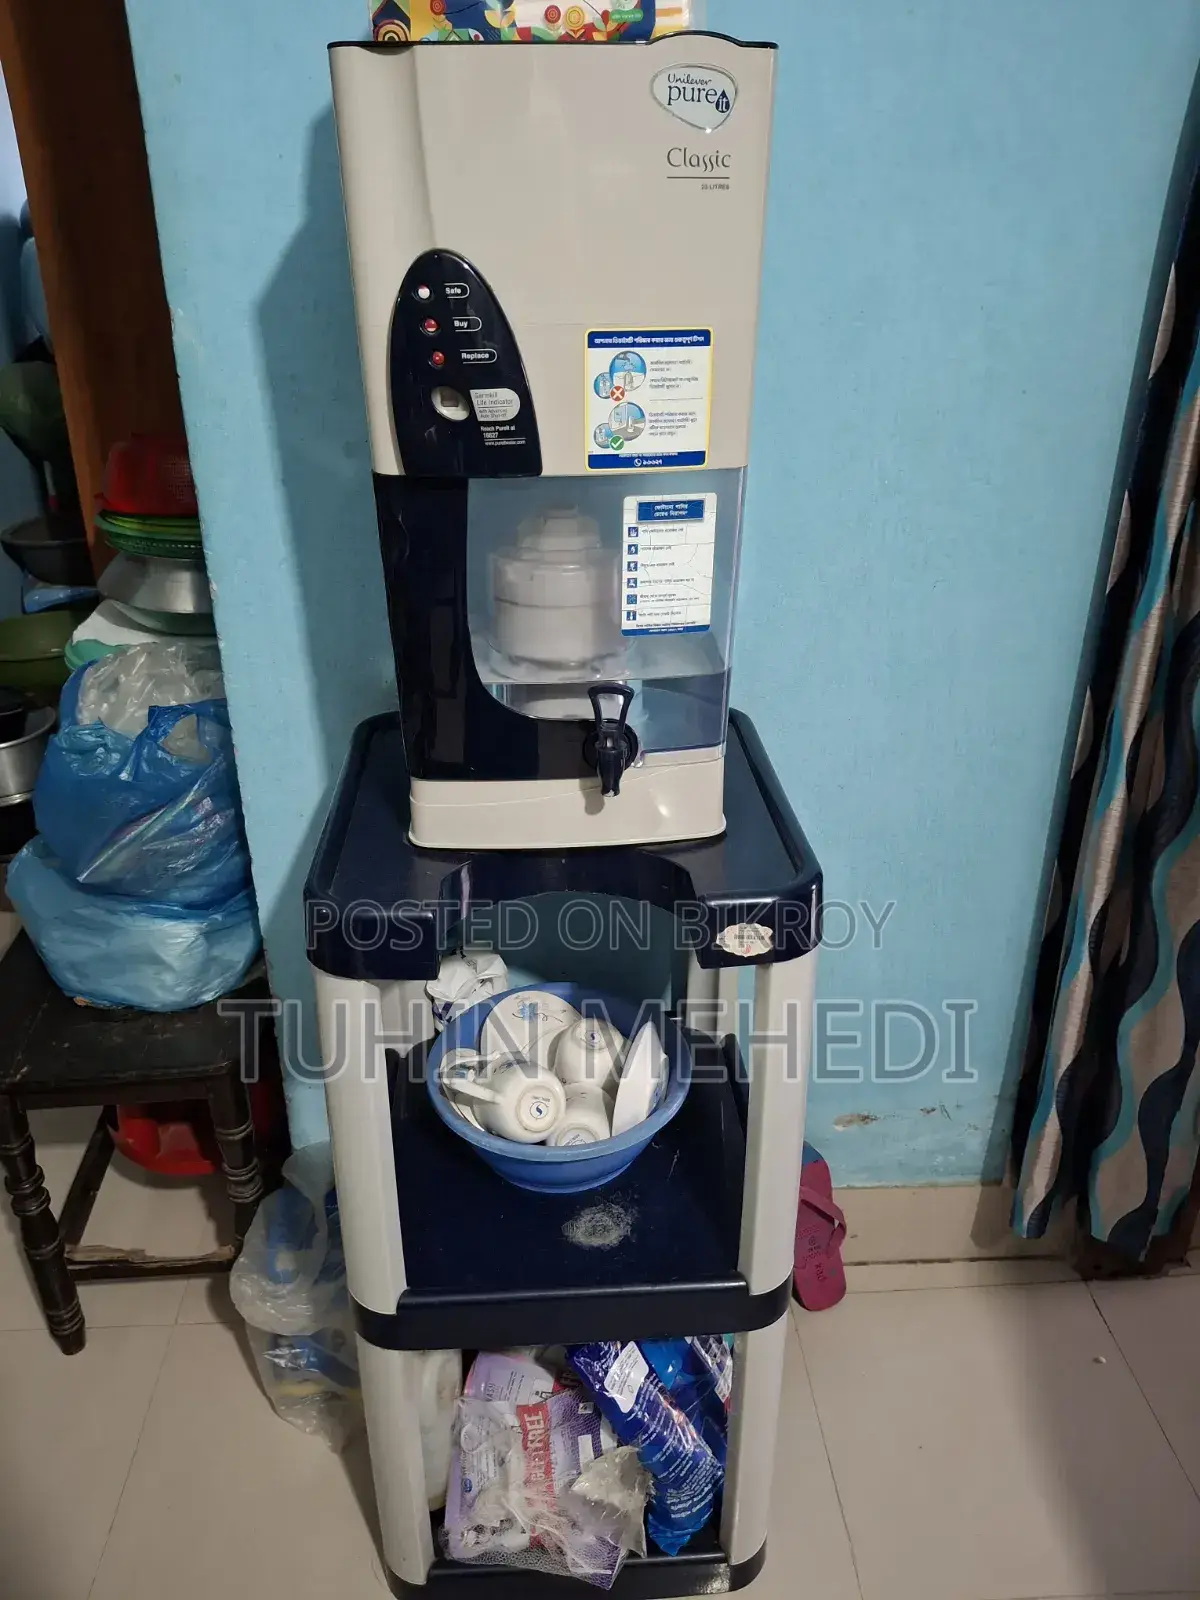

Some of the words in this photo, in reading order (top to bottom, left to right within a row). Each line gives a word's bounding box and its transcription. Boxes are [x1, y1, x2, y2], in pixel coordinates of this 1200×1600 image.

[667, 73, 712, 86] Unilever
[666, 147, 732, 173] Classic
[453, 320, 468, 328] Buy
[461, 352, 490, 360] Replace
[523, 1410, 547, 1450] FREE
